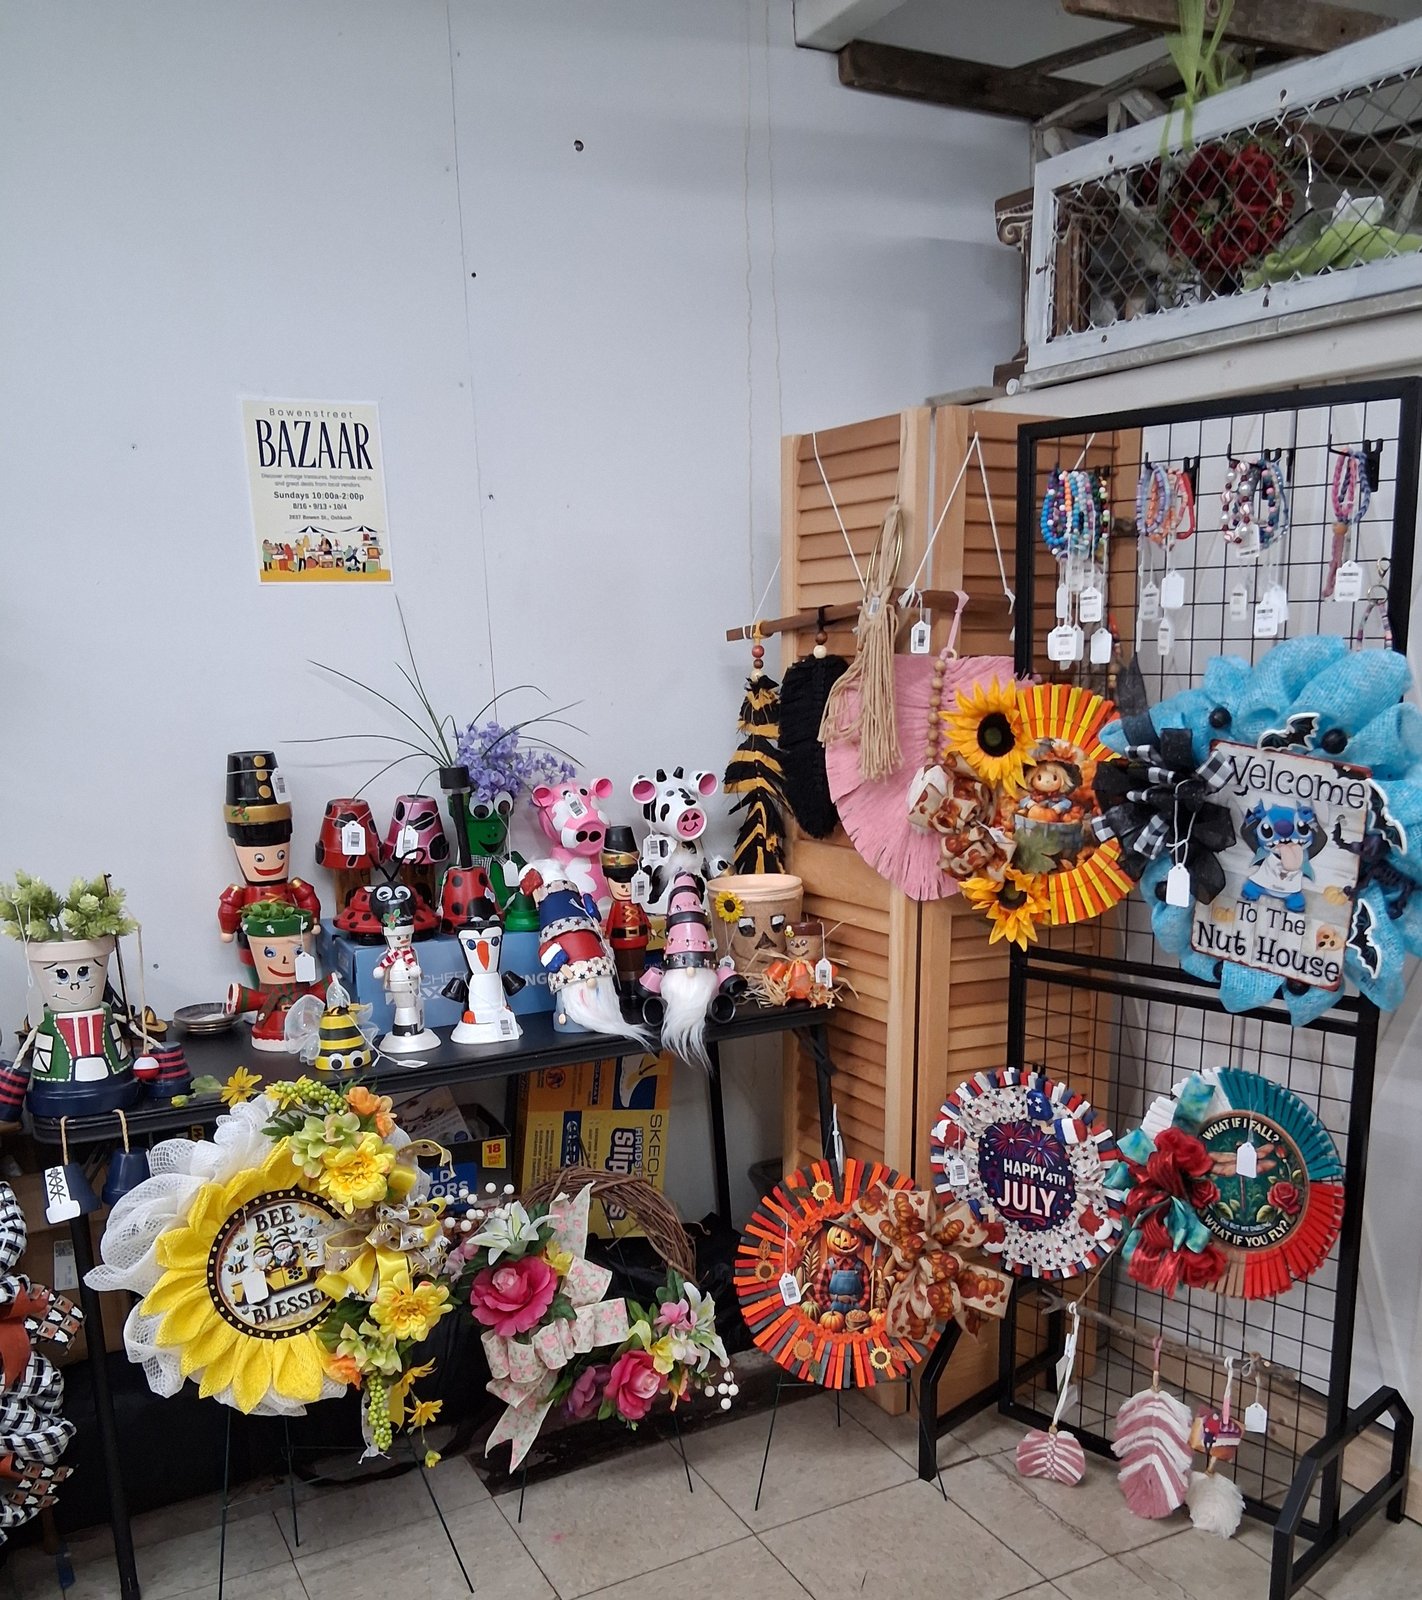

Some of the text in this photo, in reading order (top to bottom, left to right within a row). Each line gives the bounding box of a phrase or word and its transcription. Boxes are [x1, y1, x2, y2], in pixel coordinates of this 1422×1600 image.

[268, 407, 353, 419] Bowenstreet
[255, 419, 373, 470] BAZAAR
[274, 491, 364, 501] Sundays 10:00a-2:00p
[1236, 900, 1306, 936] To The
[1196, 920, 1340, 983] Nut House
[1202, 1118, 1230, 1141] WHAT
[1232, 1118, 1241, 1128] IF
[1248, 1118, 1280, 1142] FALL?
[486, 1143, 502, 1154] 18
[647, 1114, 662, 1189] SKECH
[1004, 1158, 1066, 1187] HAPPY 4TH
[996, 1179, 1056, 1218] JULY
[254, 1204, 296, 1233] BEE
[1204, 1214, 1290, 1248] WHAT IF YOU FLY?
[252, 1288, 325, 1325] BLESSE
